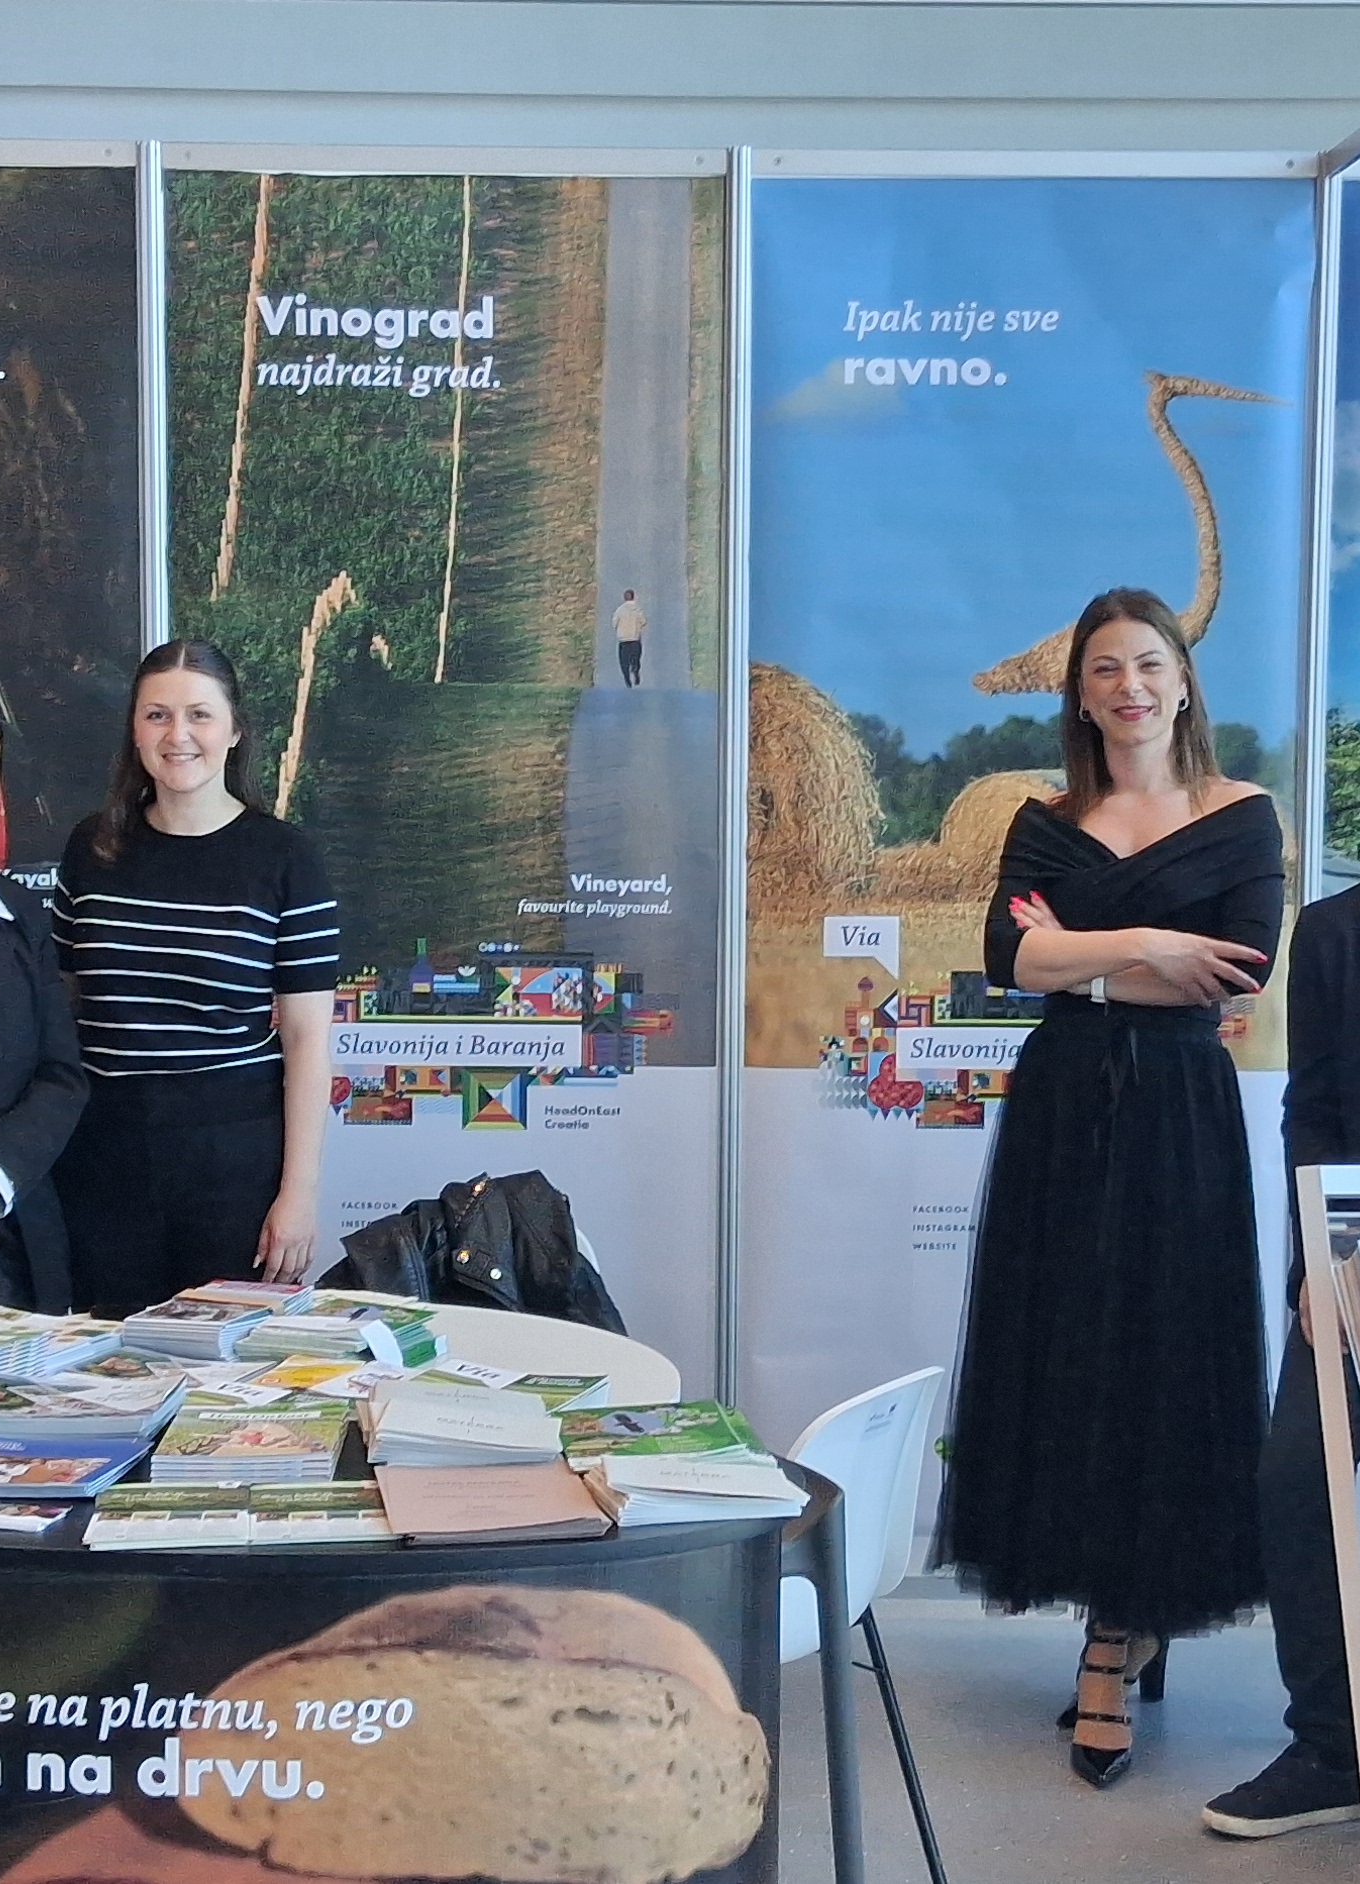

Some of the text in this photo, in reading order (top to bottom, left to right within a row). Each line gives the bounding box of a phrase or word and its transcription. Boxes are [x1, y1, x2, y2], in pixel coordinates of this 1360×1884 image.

[256, 292, 494, 349] Vinograd
[843, 300, 1060, 342] Ipak nije sve
[256, 353, 502, 398] najdraži grad.
[843, 357, 1008, 387] ravno.
[570, 873, 673, 897] Vineyard,
[517, 898, 673, 918] favourite playground.
[840, 925, 881, 947] Via
[336, 1032, 566, 1061] Slavonija i Baranja
[910, 1037, 1022, 1066] Slavonija
[544, 1119, 590, 1130] Croatia
[341, 1201, 398, 1210] FACEBOOK
[912, 1205, 969, 1214] FACEBOOK
[912, 1224, 976, 1232] INSTAGRAM
[912, 1242, 957, 1251] WEBSITE
[26, 1693, 88, 1728] na
[98, 1683, 279, 1741] platnu,
[295, 1696, 414, 1744] nego
[25, 1749, 113, 1796] na
[136, 1736, 327, 1801] drvu.
